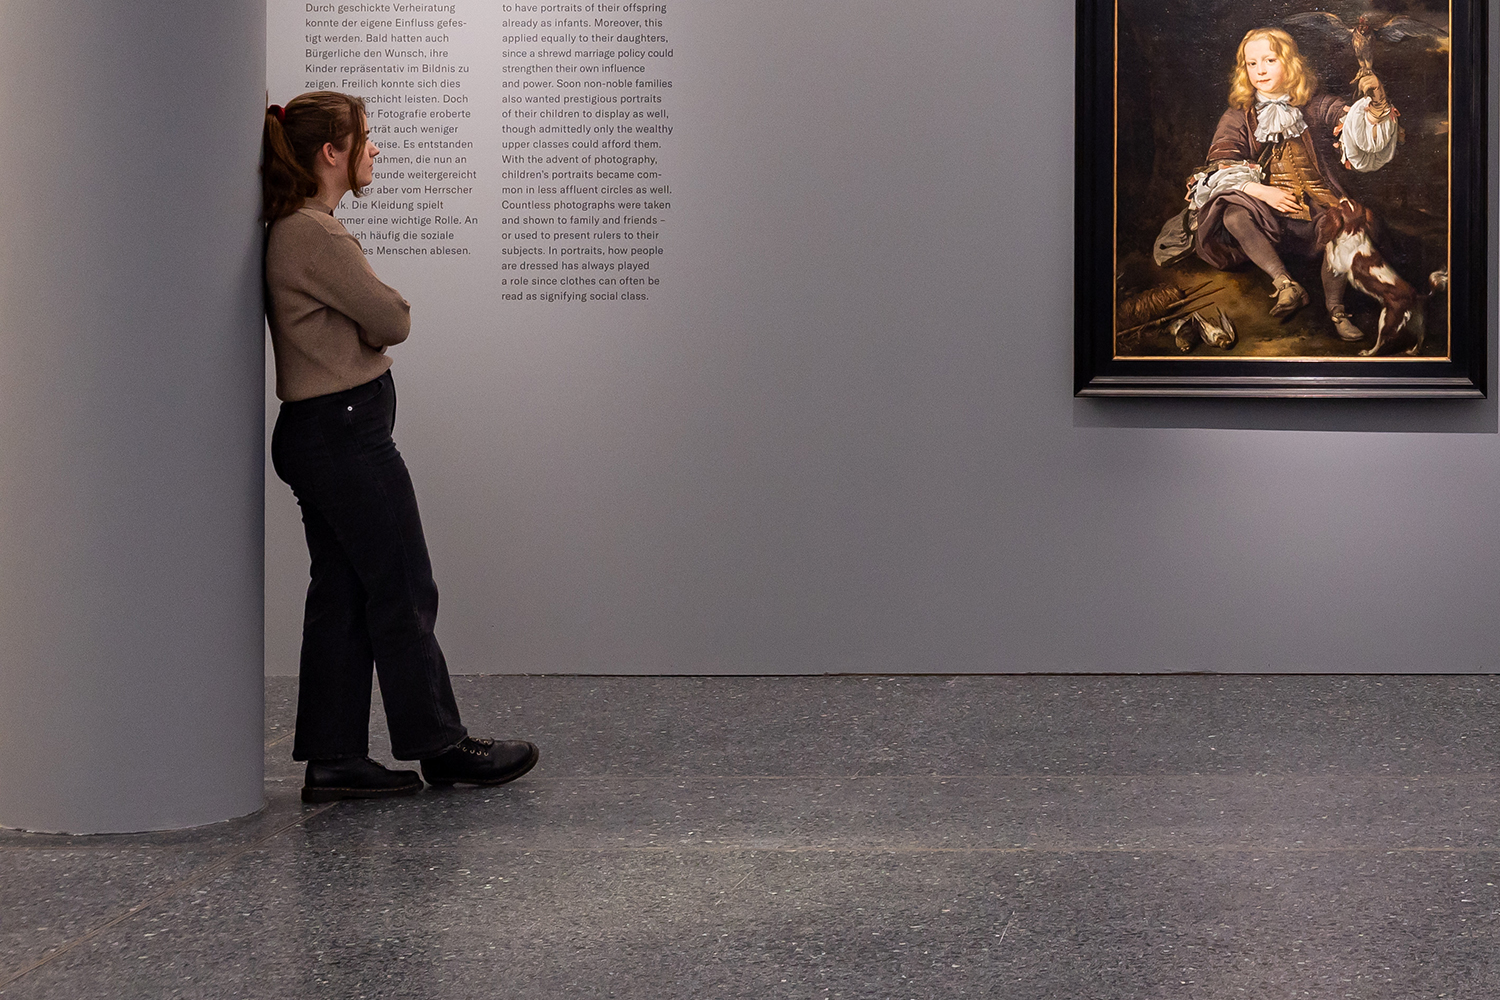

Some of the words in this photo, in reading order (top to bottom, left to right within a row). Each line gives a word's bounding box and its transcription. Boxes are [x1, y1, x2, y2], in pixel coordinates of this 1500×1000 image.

[305, 3, 335, 13] Durch
[337, 3, 391, 15] geschickte
[392, 3, 456, 15] Verheiratung
[305, 18, 339, 28] konnte
[341, 18, 358, 28] der
[360, 18, 393, 30] eigene
[395, 18, 435, 28] Einfluss
[436, 18, 467, 30] gefes-
[502, 18, 538, 30] already
[540, 20, 552, 28] as
[554, 18, 591, 28] infants.
[594, 18, 642, 28] Moreover,
[644, 18, 663, 28] this
[305, 48, 361, 60] Bürgerliche
[363, 48, 382, 58] den
[384, 48, 427, 58] Wunsch,
[429, 48, 449, 58] ihre
[502, 49, 527, 58] since
[529, 50, 535, 58] a
[537, 48, 572, 58] shrewd
[574, 48, 615, 60] marriage
[617, 48, 646, 60] policy
[647, 48, 674, 58] could
[305, 64, 338, 73] Kinder
[340, 64, 405, 75] repräsentativ
[407, 64, 419, 73] im
[422, 63, 456, 73] Bildnis
[502, 64, 553, 75] strengthen
[555, 63, 578, 73] their
[579, 65, 599, 73] own
[601, 63, 646, 73] influence
[305, 79, 338, 90] zeigen.
[341, 78, 378, 89] Freilich
[381, 79, 415, 89] konnte
[417, 79, 438, 88] sich
[440, 79, 461, 88] dies
[502, 79, 520, 88] and
[522, 81, 554, 90] power.
[556, 78, 581, 88] Soon
[583, 79, 633, 88] non-noble
[635, 78, 673, 88] families
[501, 94, 523, 104] also
[524, 94, 561, 104] wanted
[563, 94, 618, 106] prestigious
[620, 94, 662, 105] portraits
[377, 109, 427, 121] Fotografie
[429, 109, 471, 119] eroberte
[501, 124, 536, 136] though
[538, 124, 592, 136] admittedly
[593, 124, 615, 136] only
[616, 124, 633, 134] the
[635, 124, 674, 136] wealthy
[403, 139, 415, 149] Es
[417, 139, 473, 149] entstanden
[502, 141, 530, 151] upper
[532, 139, 570, 149] classes
[571, 139, 599, 149] could
[601, 139, 631, 149] afford
[633, 139, 662, 149] them.
[415, 154, 431, 164] die
[433, 156, 452, 164] nun
[454, 156, 467, 164] an
[371, 170, 404, 179] reunde
[407, 169, 477, 182] weitergereicht
[501, 169, 549, 179] children's
[551, 170, 594, 181] portraits
[596, 170, 635, 179] became
[637, 171, 662, 179] com-
[337, 200, 348, 209] lk.
[352, 200, 368, 209] Die
[371, 200, 414, 212] Kleidung
[416, 200, 444, 211] spielt
[501, 200, 551, 210] Countless
[553, 200, 616, 212] photographs
[617, 202, 641, 210] were
[643, 200, 671, 210] taken
[338, 217, 365, 225] mmer
[367, 215, 389, 225] eine
[390, 215, 432, 227] wichtige
[434, 215, 462, 225] Rolle.
[464, 215, 478, 224] An
[501, 246, 546, 257] subjects.
[548, 246, 558, 255] In
[560, 246, 605, 257] portraits,
[608, 246, 628, 255] how
[630, 245, 664, 257] people
[501, 291, 523, 301] read
[525, 293, 537, 301] as
[539, 291, 587, 303] signifying
[589, 291, 618, 301] social
[620, 291, 649, 301] class.
